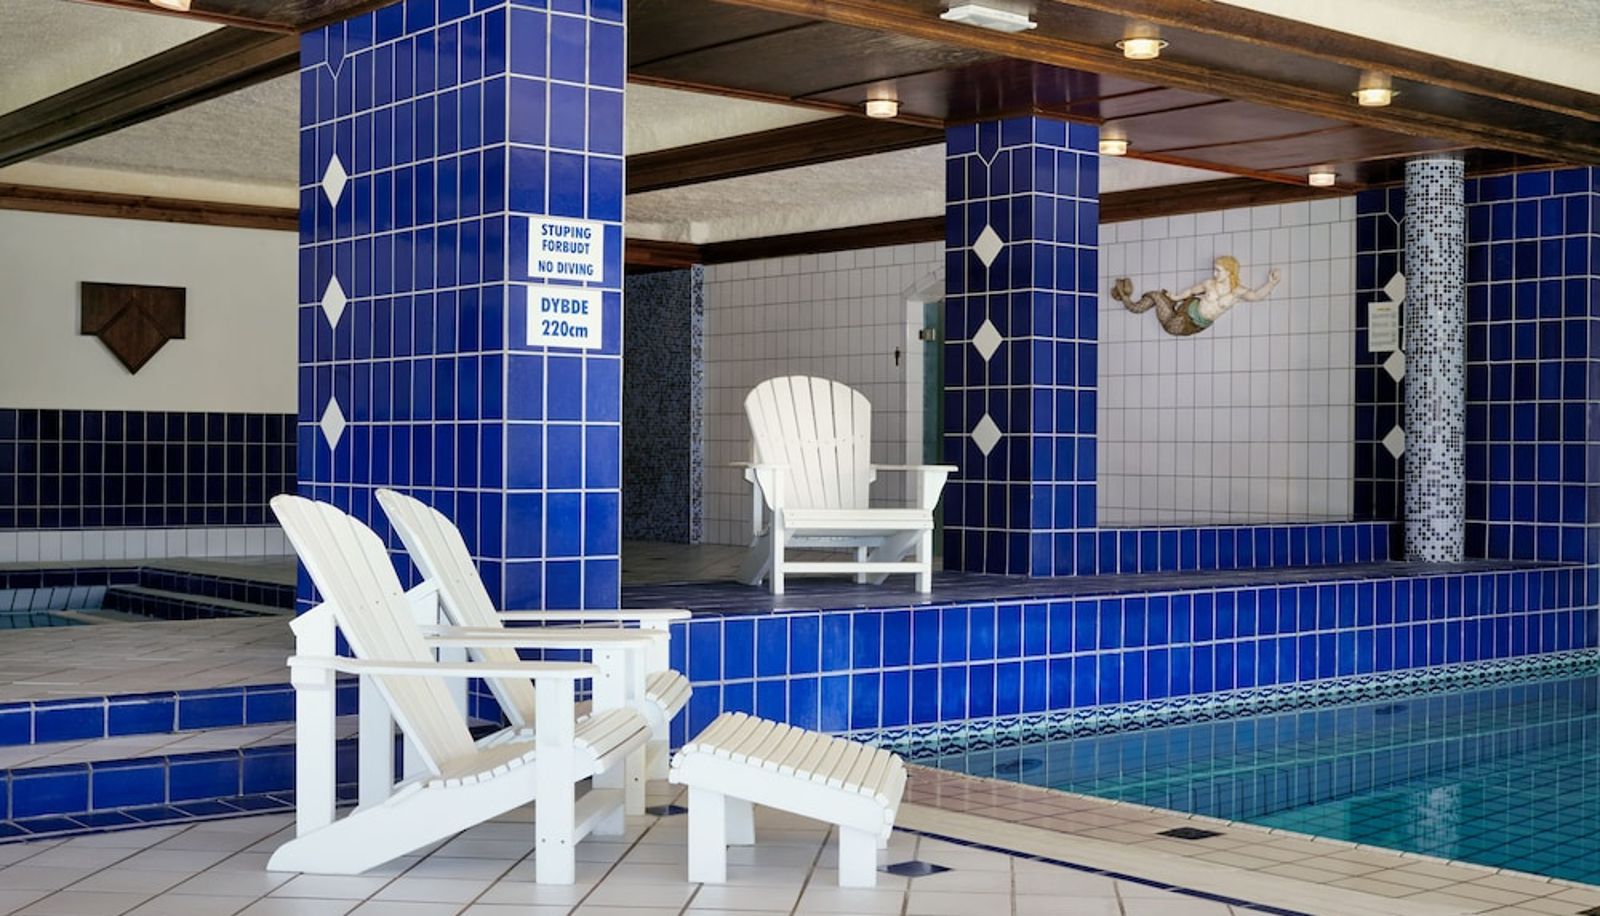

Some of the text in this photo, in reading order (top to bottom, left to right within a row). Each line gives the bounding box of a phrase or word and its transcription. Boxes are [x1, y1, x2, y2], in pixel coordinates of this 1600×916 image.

[541, 223, 591, 239] STUPING
[542, 239, 590, 255] FORBUDT
[538, 260, 594, 276] NO DIVING
[541, 297, 589, 315] DYBDE
[542, 319, 588, 338] 220cm
